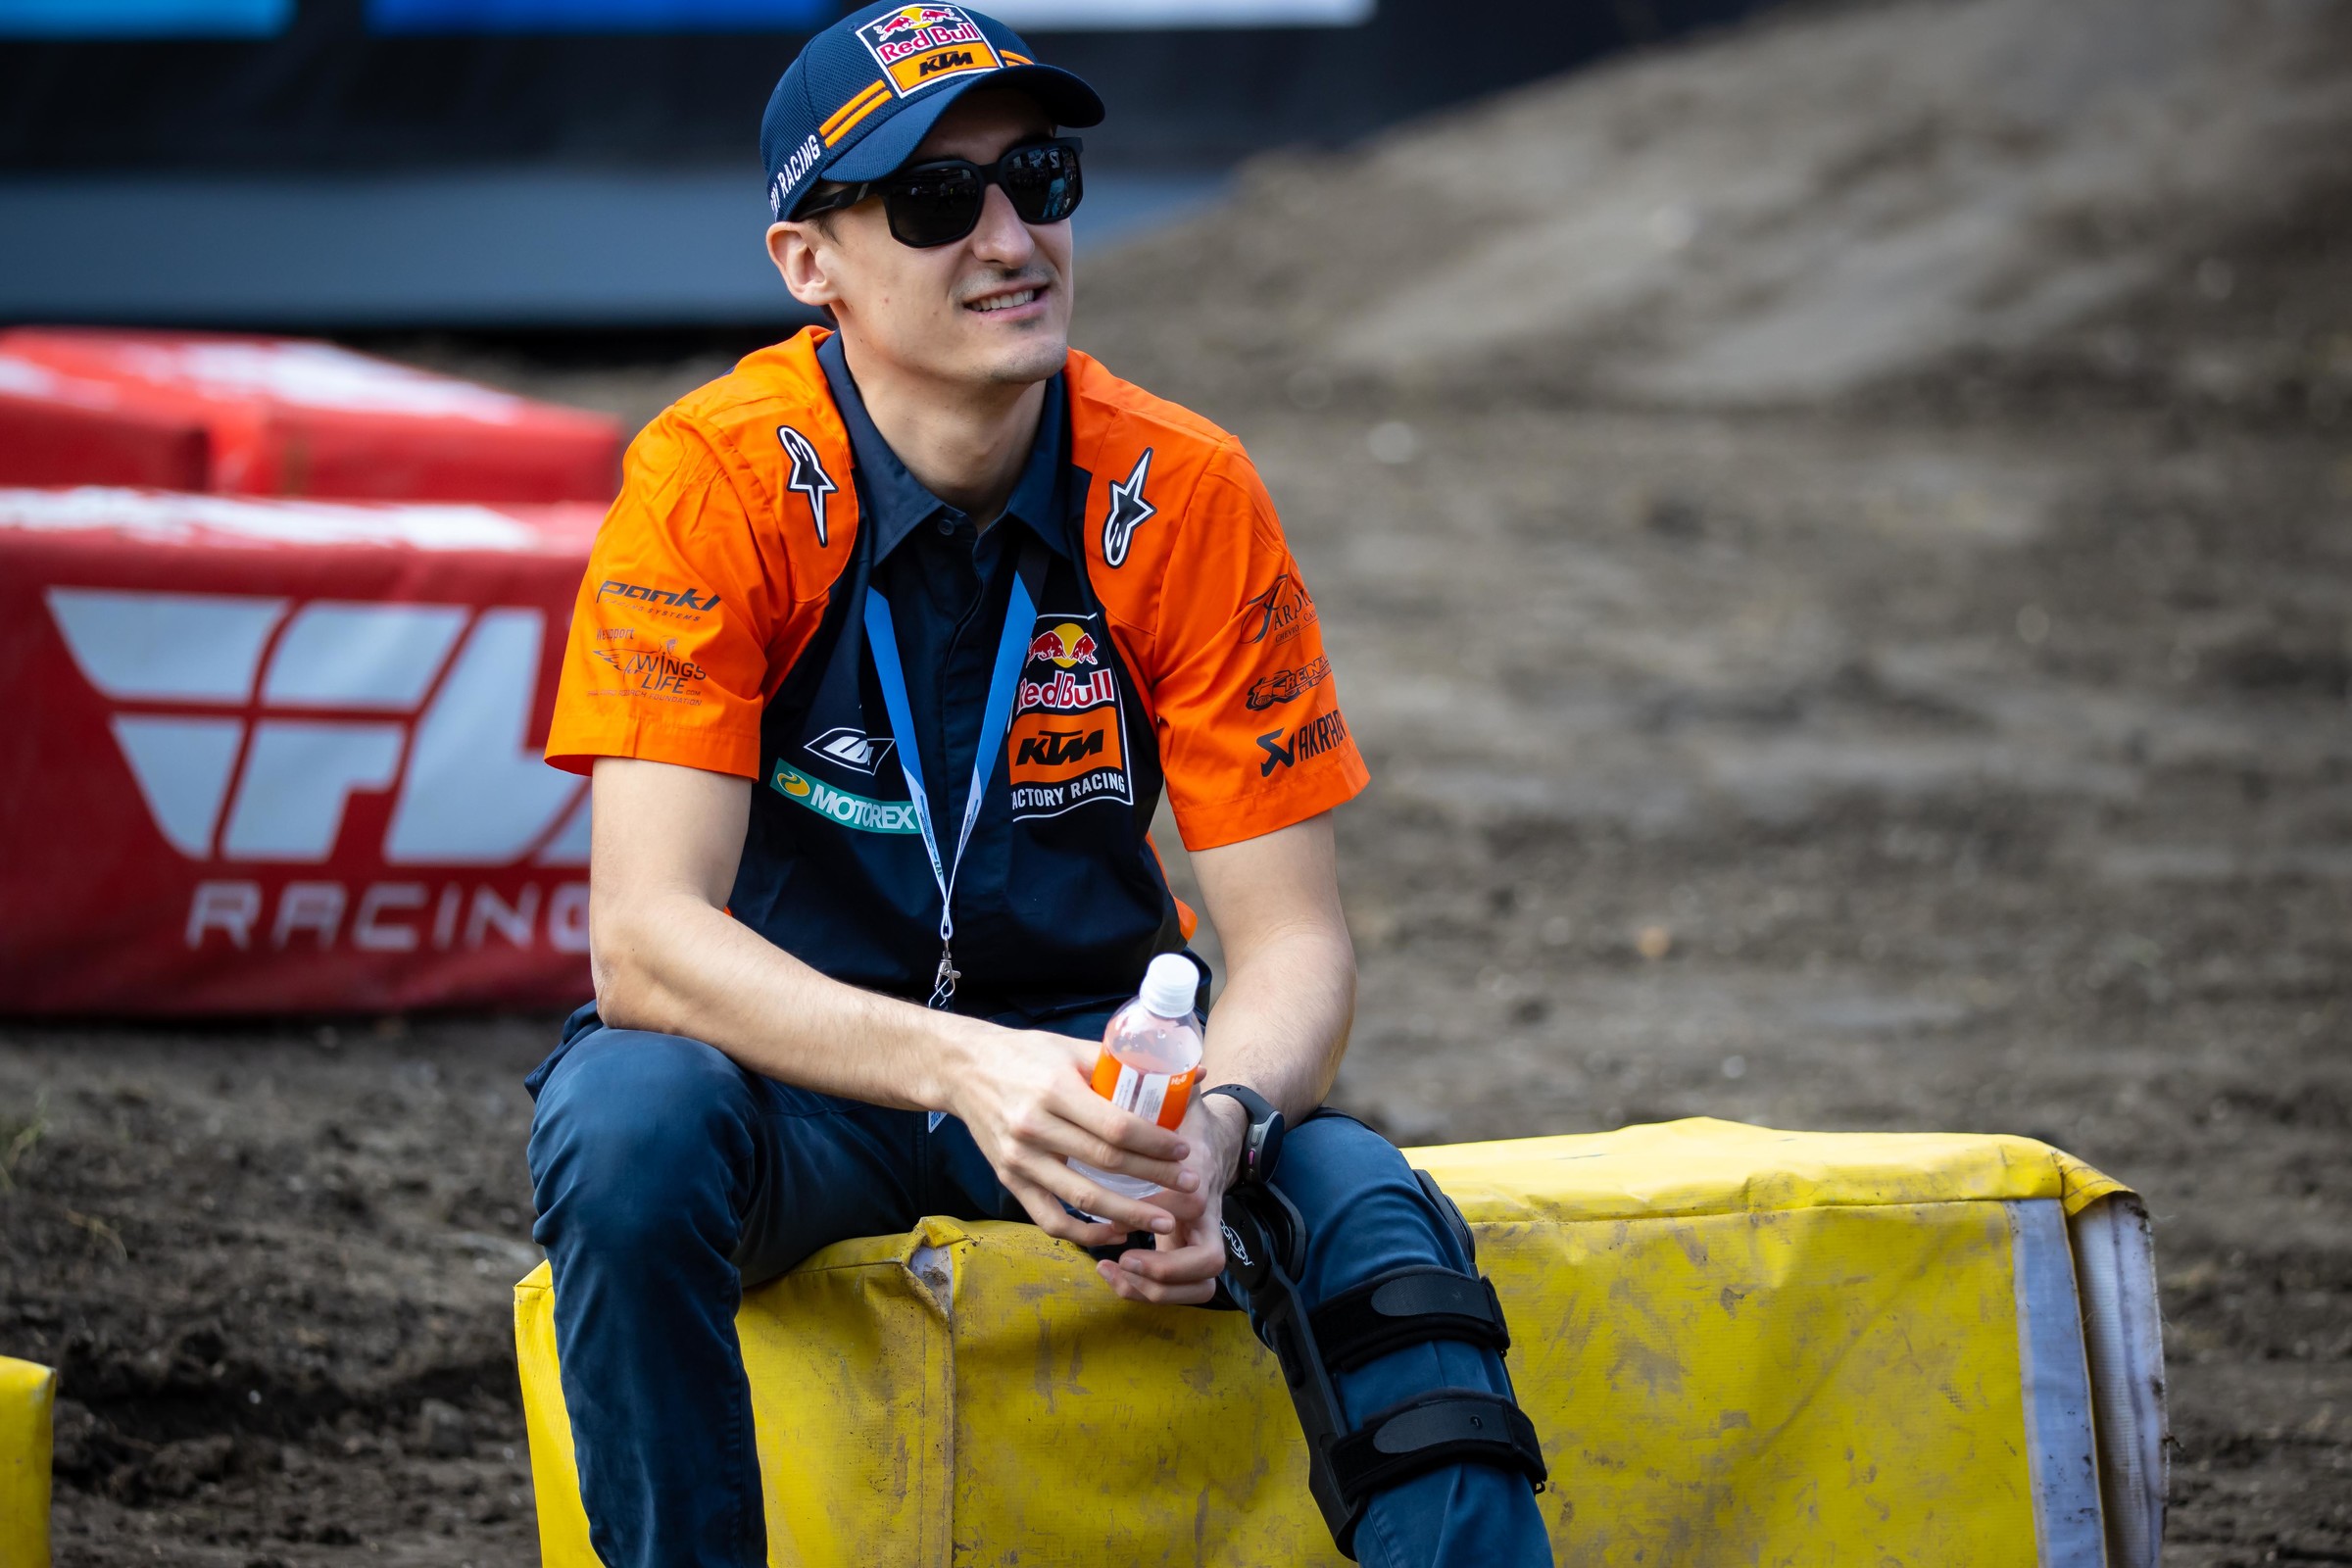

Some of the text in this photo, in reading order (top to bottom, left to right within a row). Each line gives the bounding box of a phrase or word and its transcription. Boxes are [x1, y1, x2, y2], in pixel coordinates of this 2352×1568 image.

[876, 23, 982, 65] Red Bull
[919, 51, 974, 76] KTM
[778, 134, 821, 199] RACING
[596, 579, 721, 612] pankl
[647, 608, 702, 622] SYSTEMS
[641, 672, 689, 695] LIFE
[649, 693, 703, 707] FOUNDATION
[1016, 667, 1115, 715] Red Bull
[44, 586, 590, 864] FL
[1015, 729, 1103, 766] KTM
[810, 784, 916, 830] MOTOREX
[1010, 772, 1126, 810] ACTORY RACING
